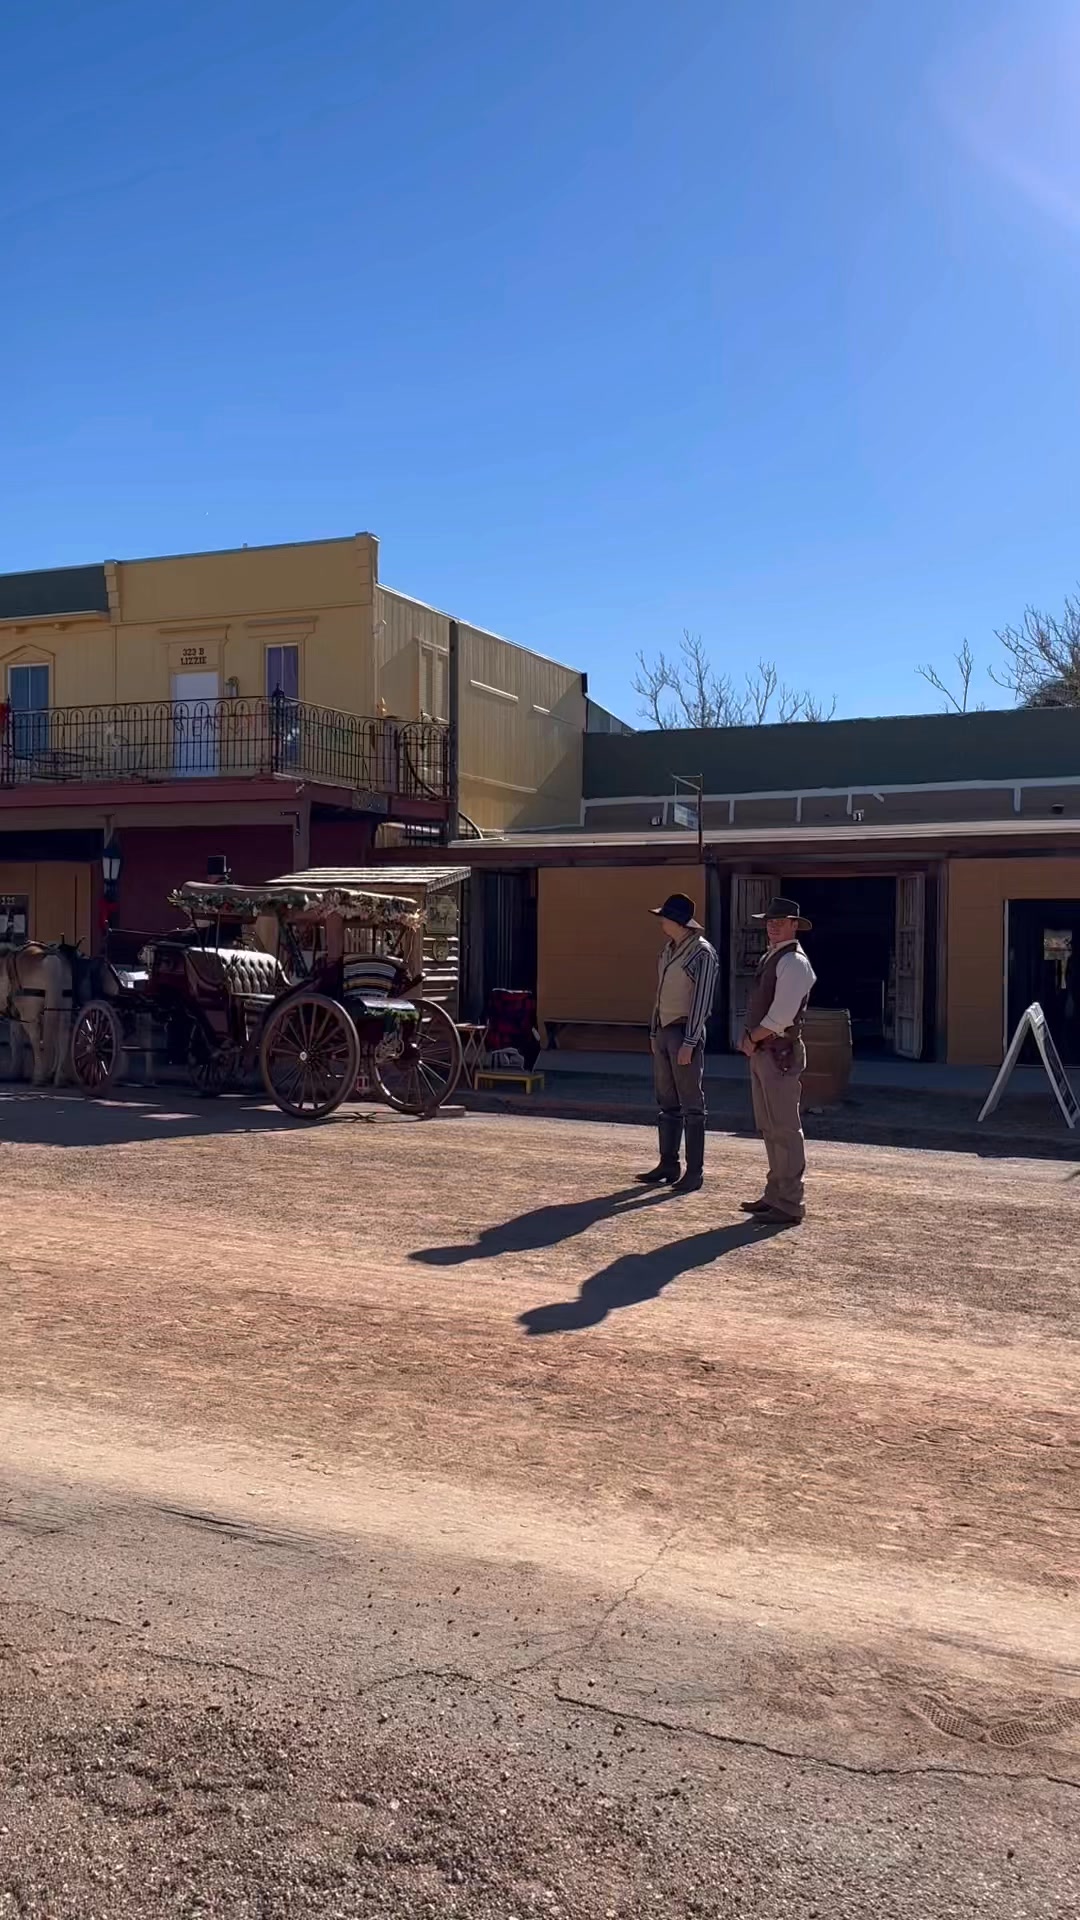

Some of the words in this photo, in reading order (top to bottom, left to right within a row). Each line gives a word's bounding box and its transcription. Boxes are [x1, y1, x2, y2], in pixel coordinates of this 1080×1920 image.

[183, 648, 197, 656] 323
[199, 647, 205, 656] B
[180, 656, 207, 665] LIZZIE
